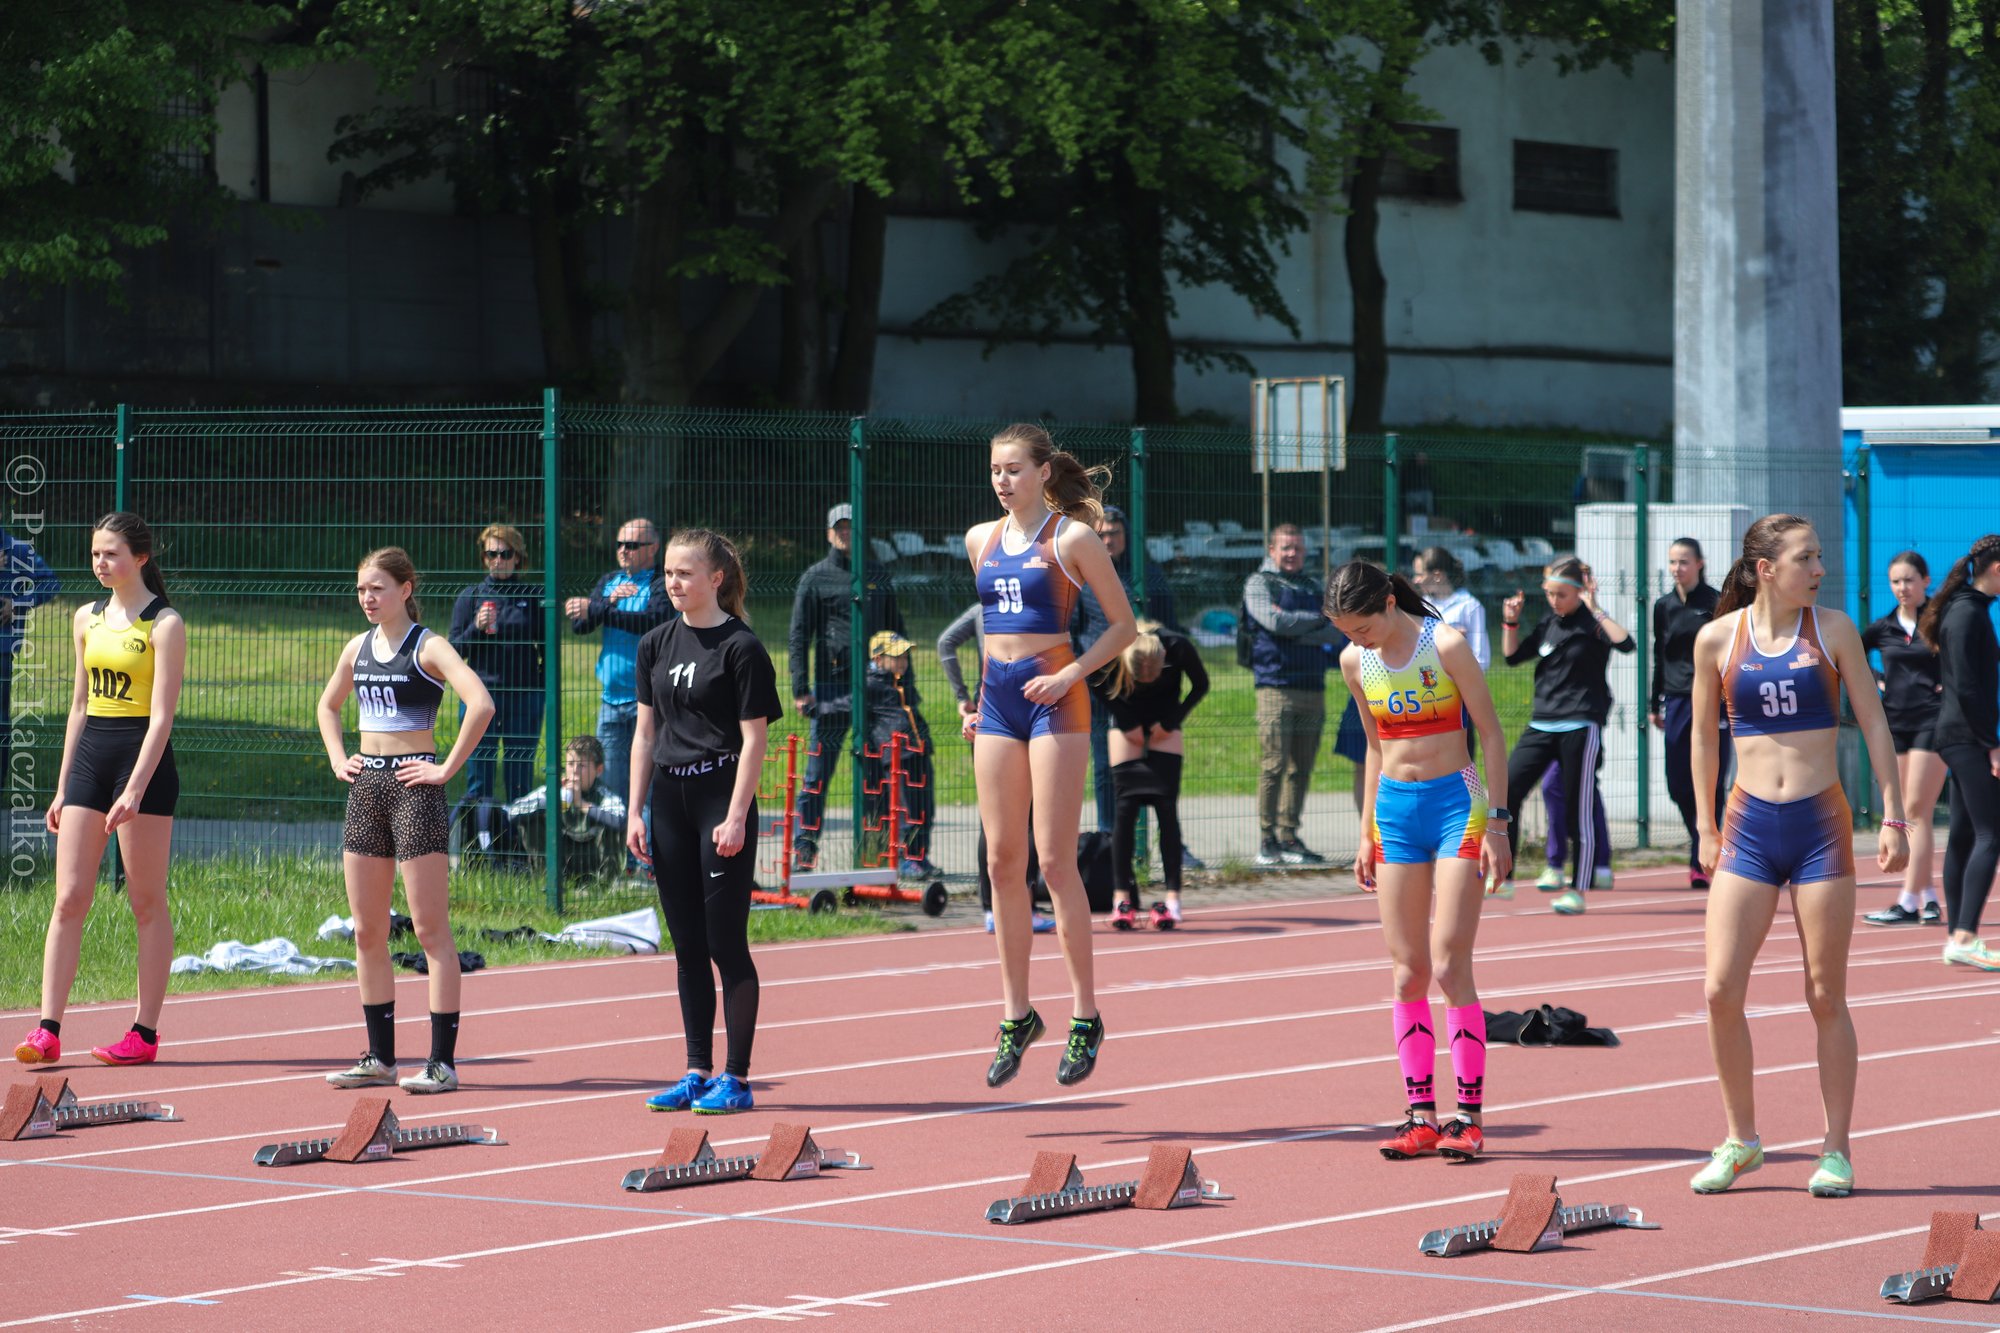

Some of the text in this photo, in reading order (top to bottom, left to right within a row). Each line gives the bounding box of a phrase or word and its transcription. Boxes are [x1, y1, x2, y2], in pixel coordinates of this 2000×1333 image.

[994, 578, 1023, 613] 39
[91, 667, 133, 701] 402
[668, 661, 697, 689] 11
[359, 685, 398, 718] 869
[1388, 690, 1422, 715] 65
[1759, 679, 1798, 718] 35
